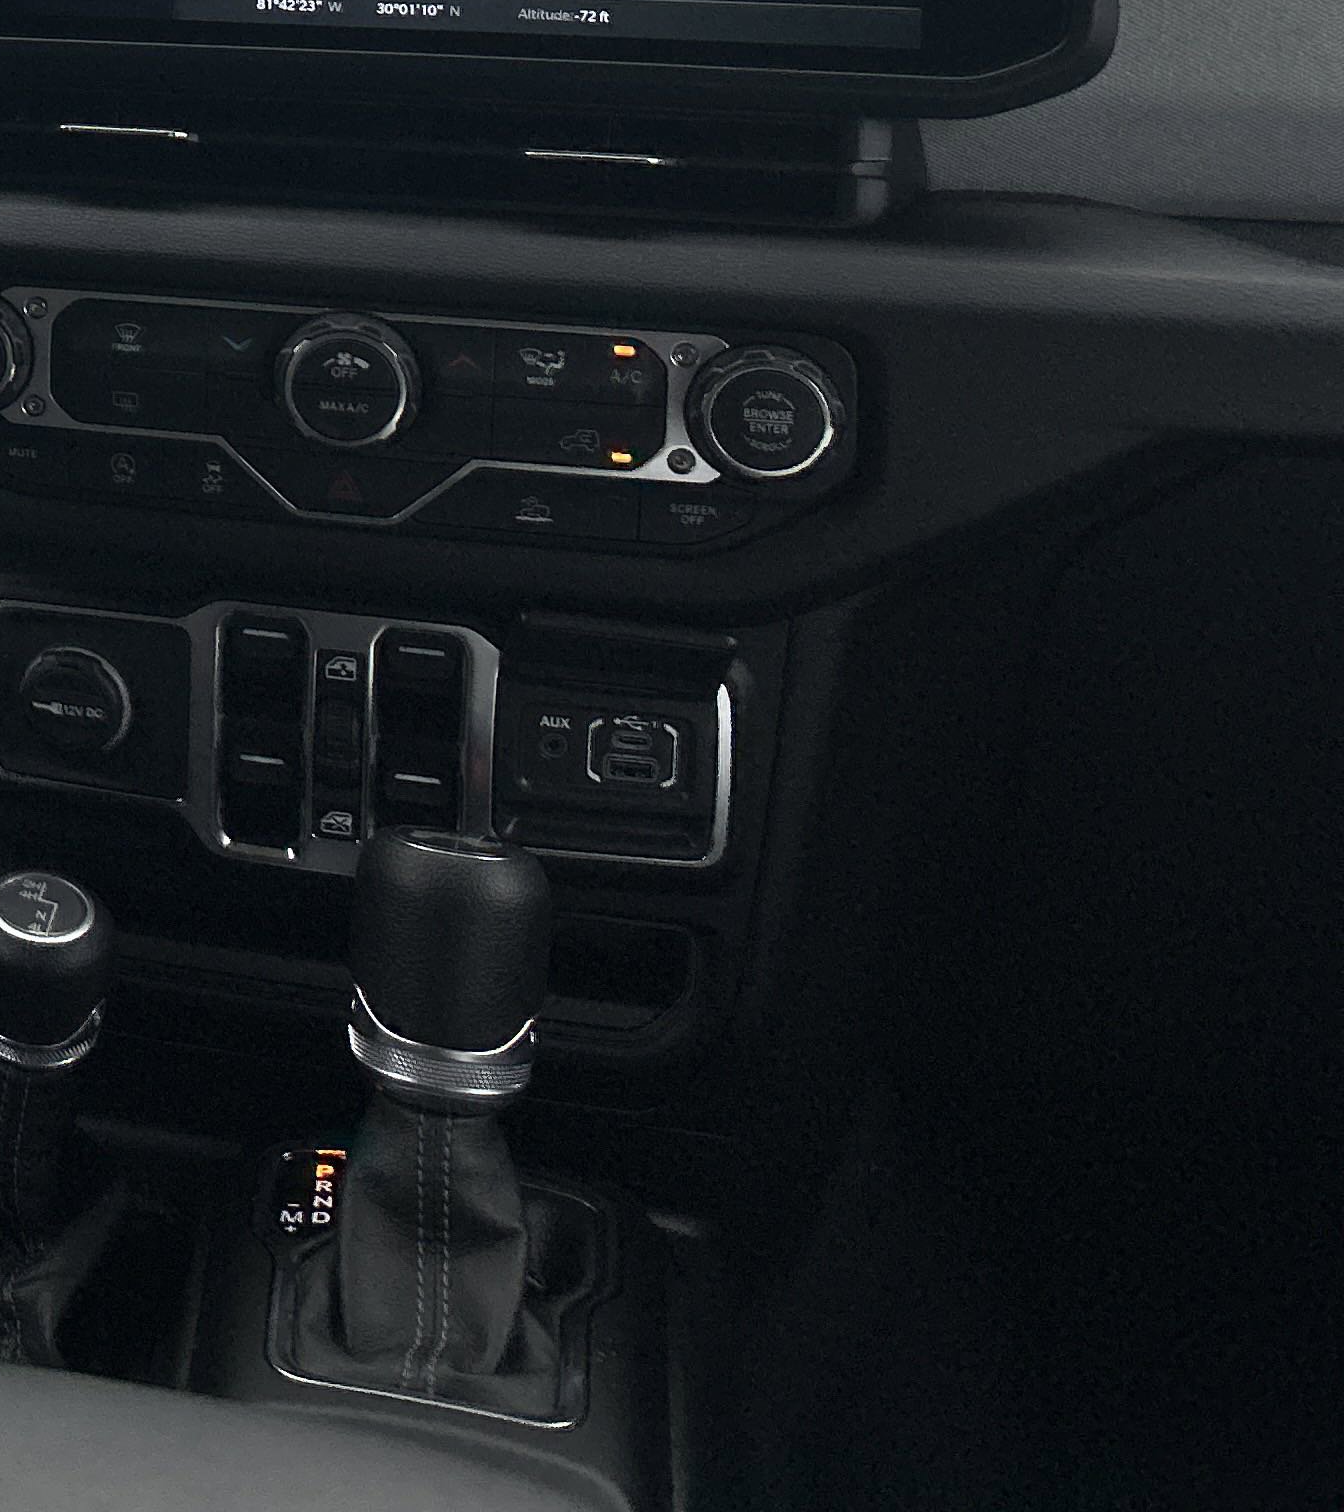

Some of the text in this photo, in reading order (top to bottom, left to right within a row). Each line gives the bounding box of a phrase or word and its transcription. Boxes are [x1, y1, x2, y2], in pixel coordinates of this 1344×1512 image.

[327, 1, 343, 13] W
[449, 6, 461, 17] N
[598, 11, 611, 23] ft
[330, 366, 358, 380] OFF
[609, 368, 643, 385] A/C
[318, 399, 370, 415] MAX A/C
[743, 408, 795, 421] BROWSE
[748, 422, 789, 434] ENTER
[8, 447, 39, 459] MUTE
[670, 502, 718, 518] SCREEN
[680, 515, 705, 526] OFF
[64, 703, 106, 719] 12V DC
[539, 714, 571, 729] AUX
[36, 909, 47, 922] N
[316, 1164, 335, 1178] P
[315, 1179, 333, 1192] R
[312, 1195, 333, 1208] N
[280, 1209, 304, 1223] M
[311, 1211, 331, 1224] D
